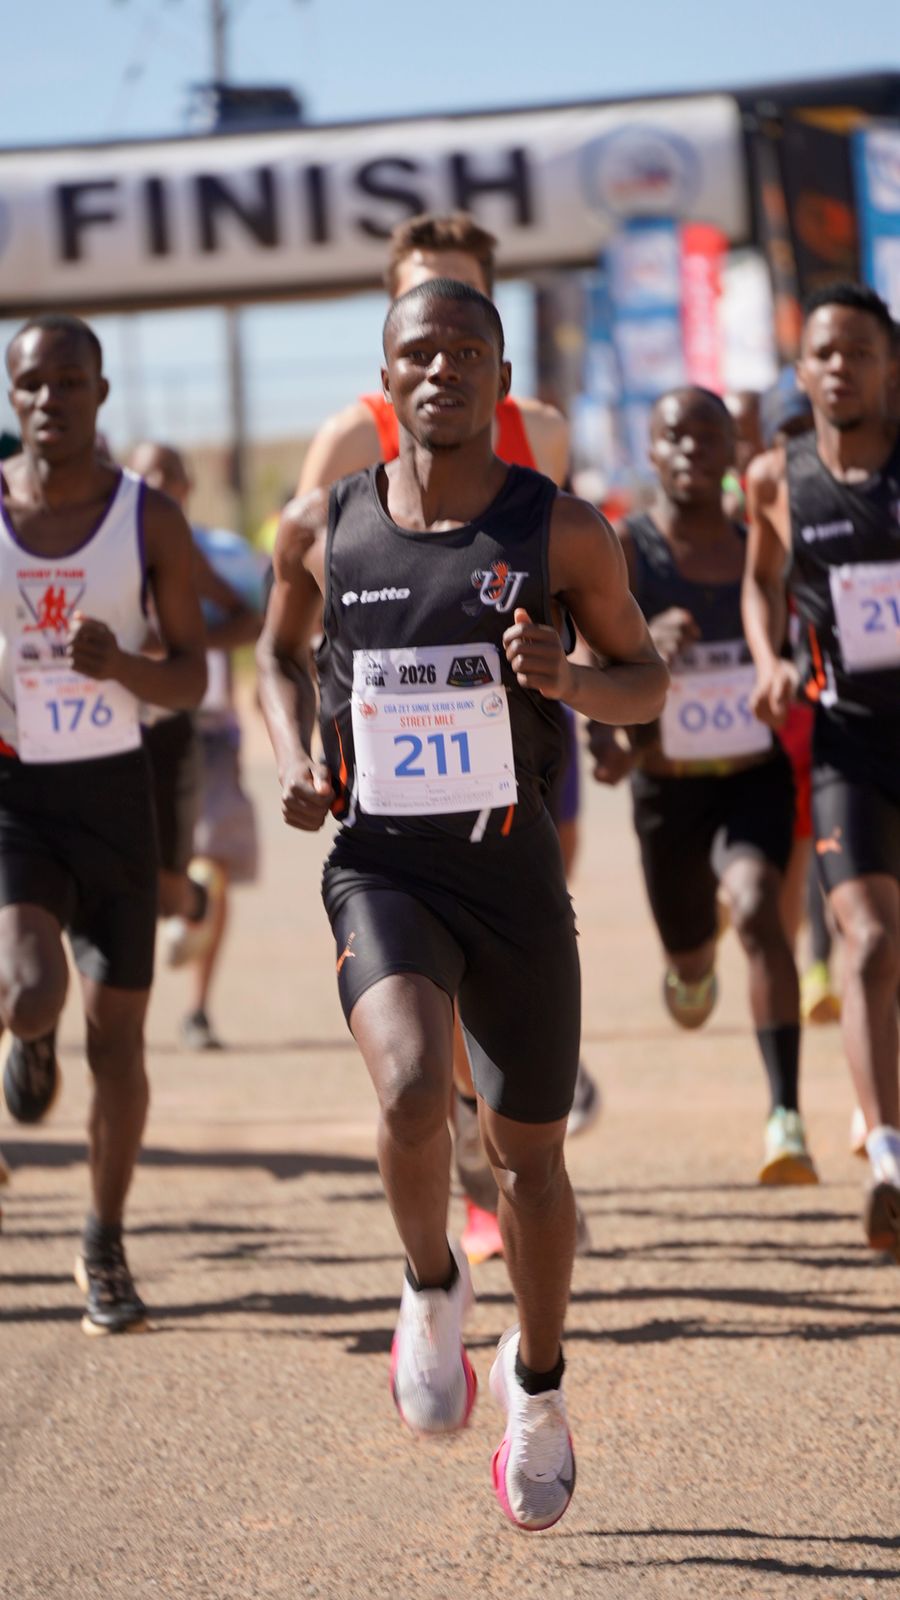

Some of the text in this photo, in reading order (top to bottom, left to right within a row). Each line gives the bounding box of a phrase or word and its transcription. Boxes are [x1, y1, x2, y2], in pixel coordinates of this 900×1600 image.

[56, 147, 534, 262] FINISH
[399, 664, 437, 684] 2026
[452, 658, 487, 676] ASA
[45, 694, 113, 733] 176
[400, 713, 456, 728] STREET MILE
[394, 731, 471, 777] 211
